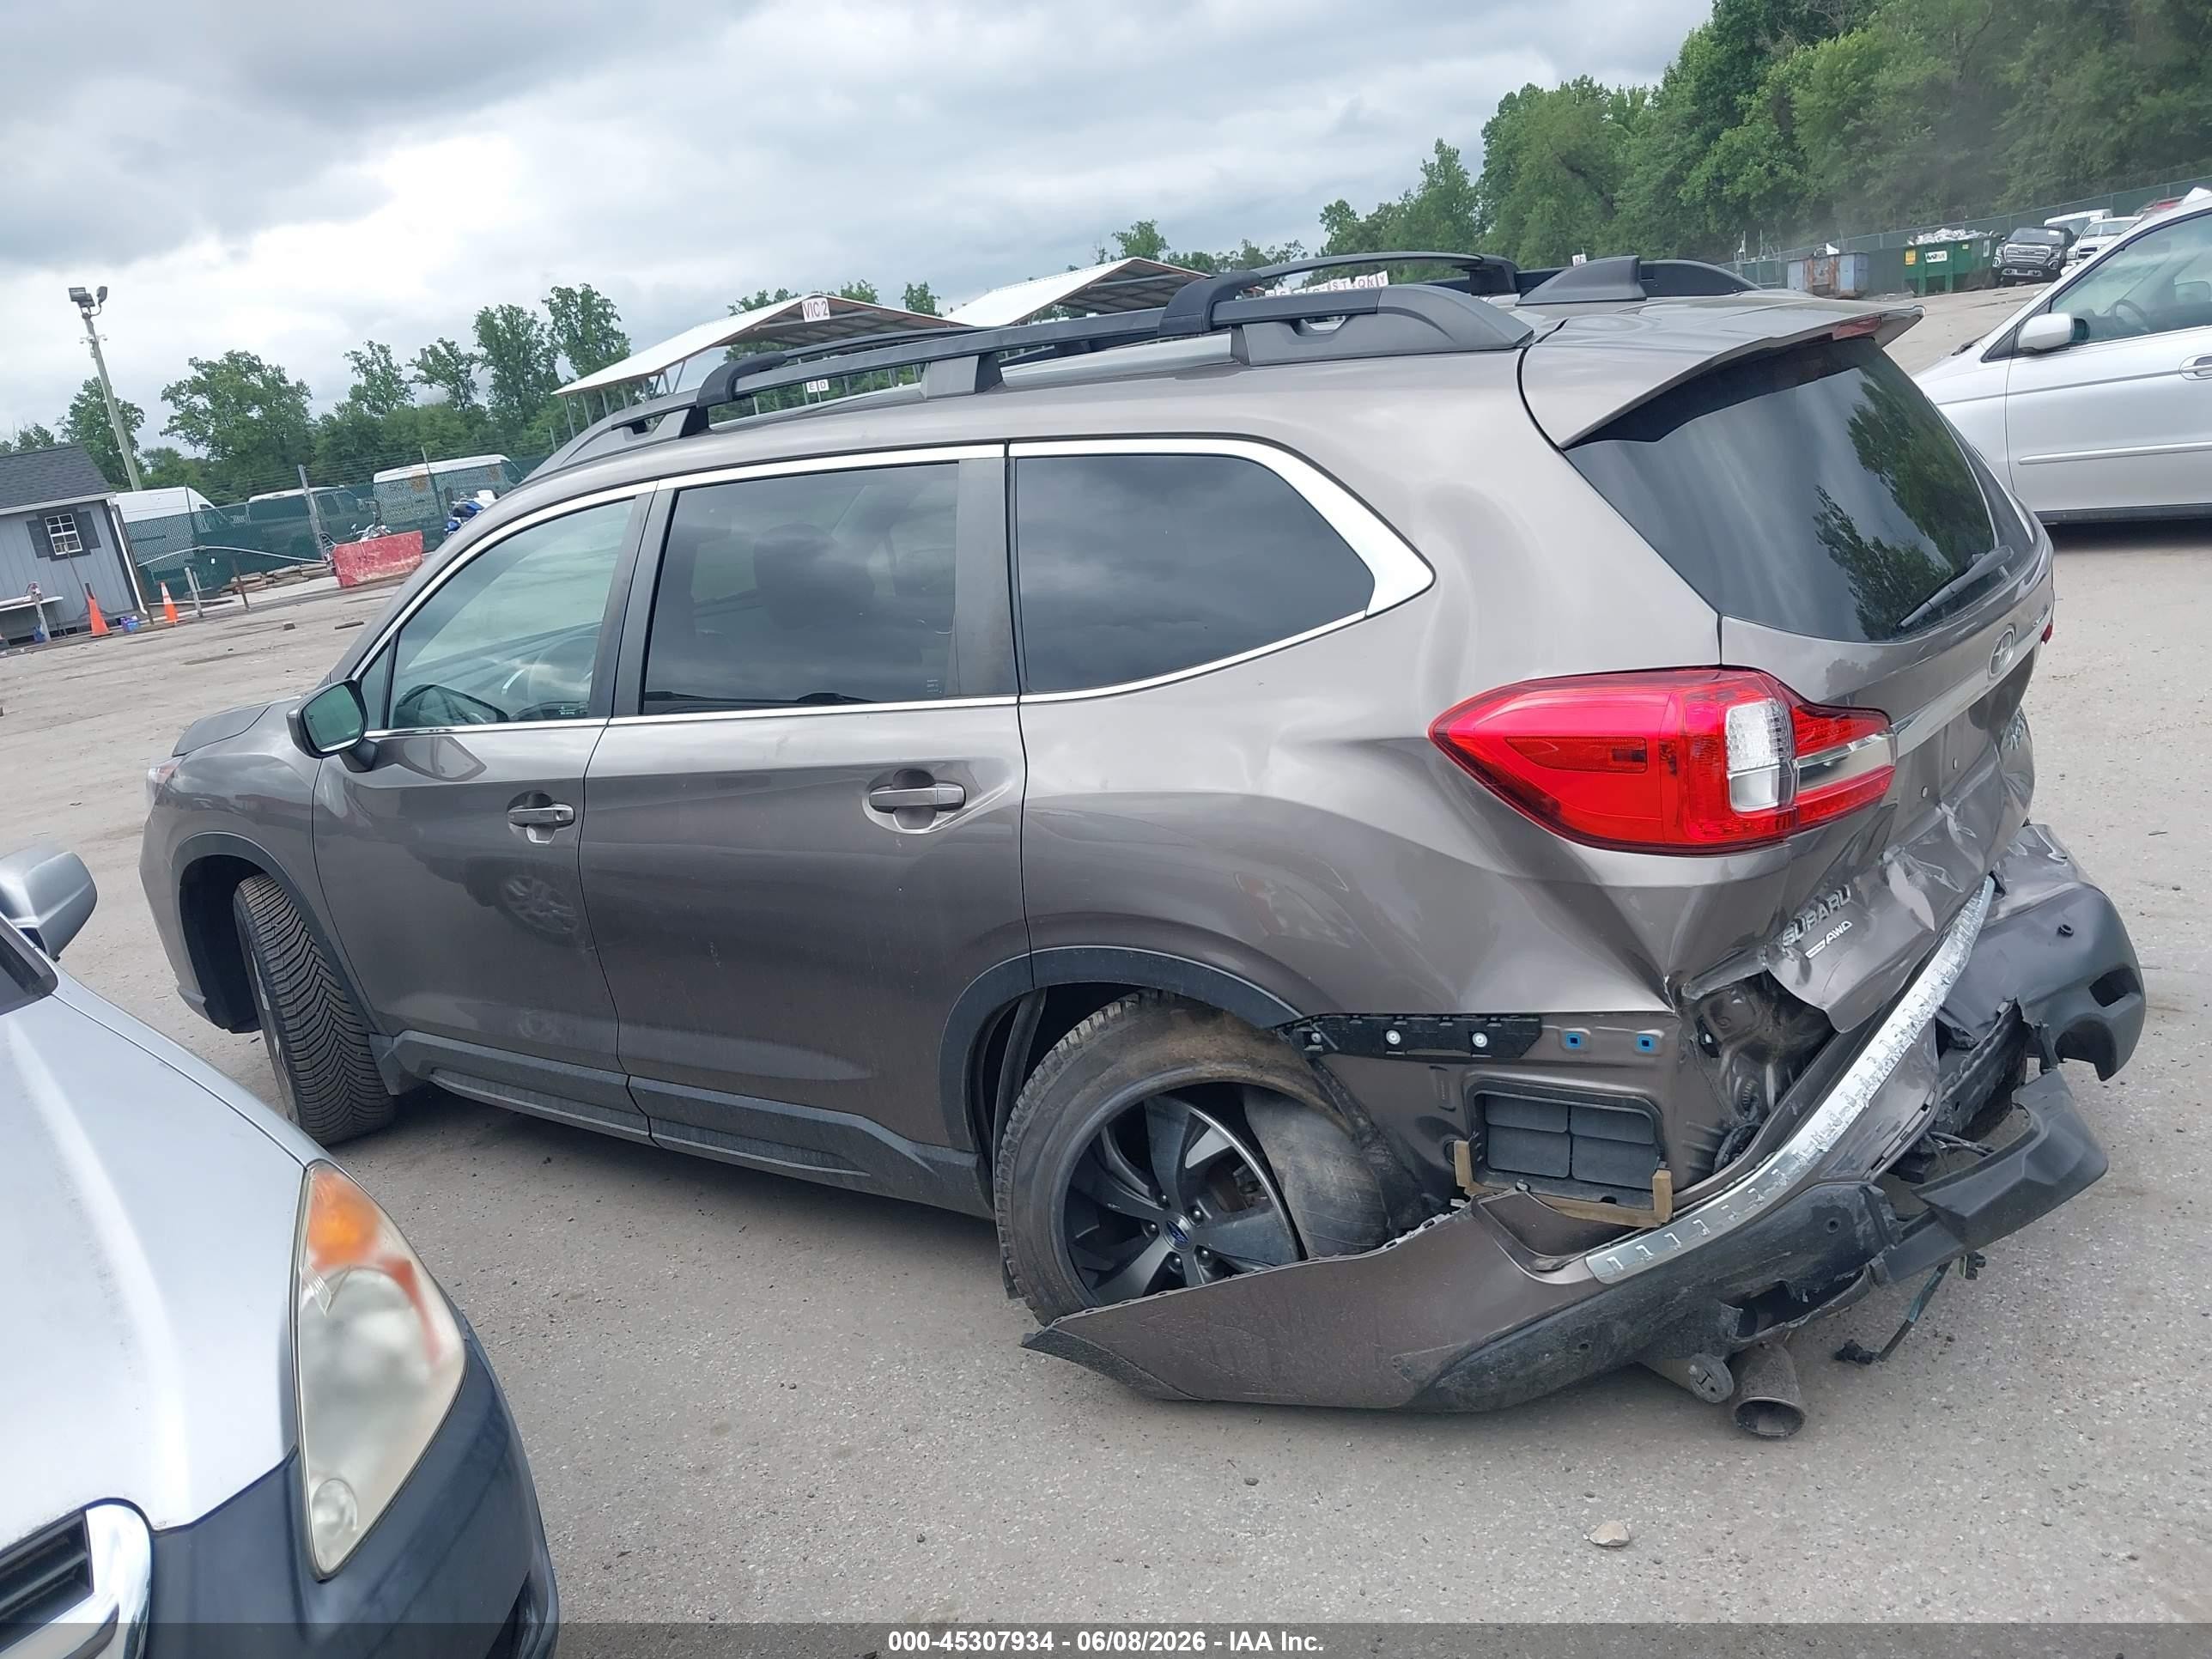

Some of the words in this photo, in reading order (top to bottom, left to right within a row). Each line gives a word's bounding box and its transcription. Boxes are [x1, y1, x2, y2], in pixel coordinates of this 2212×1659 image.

[803, 301, 820, 319] VIC
[821, 301, 829, 316] 2
[1781, 884, 1851, 947] SUBARU
[1825, 920, 1853, 945] AWD
